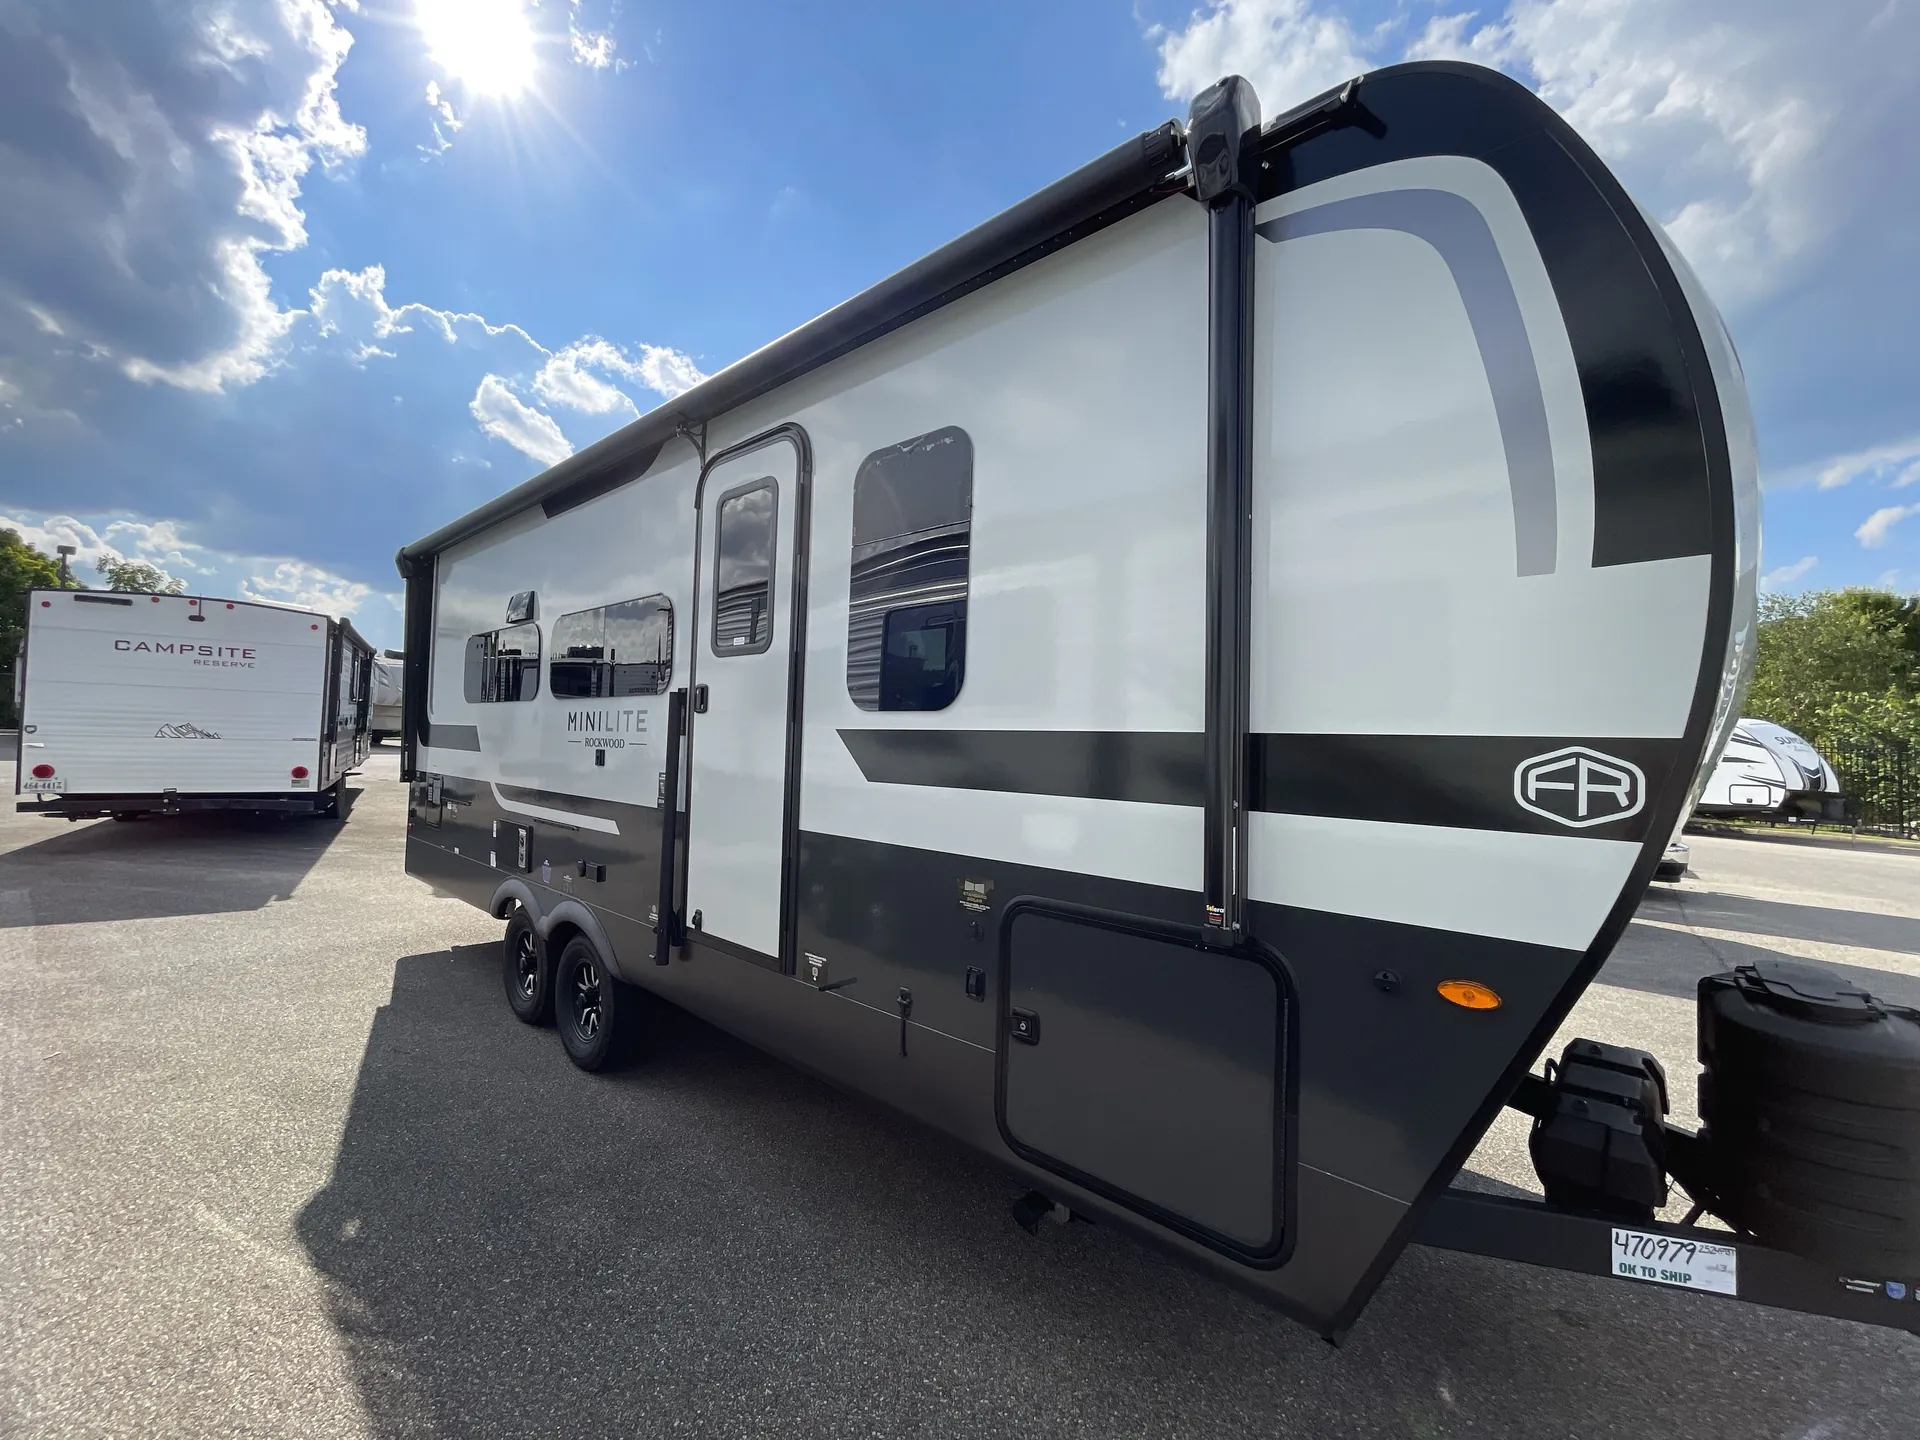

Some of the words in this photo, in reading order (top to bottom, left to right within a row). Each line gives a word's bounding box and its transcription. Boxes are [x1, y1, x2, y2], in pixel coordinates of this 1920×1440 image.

[114, 640, 257, 659] CAMPSITE
[193, 659, 256, 669] RESERVE
[584, 737, 625, 749] ROCKWOOD
[1527, 757, 1631, 817] FR
[1614, 1231, 1698, 1265] 470979
[1619, 1262, 1638, 1276] OK
[1640, 1265, 1657, 1279] TO
[1660, 1269, 1692, 1284] SHIP
